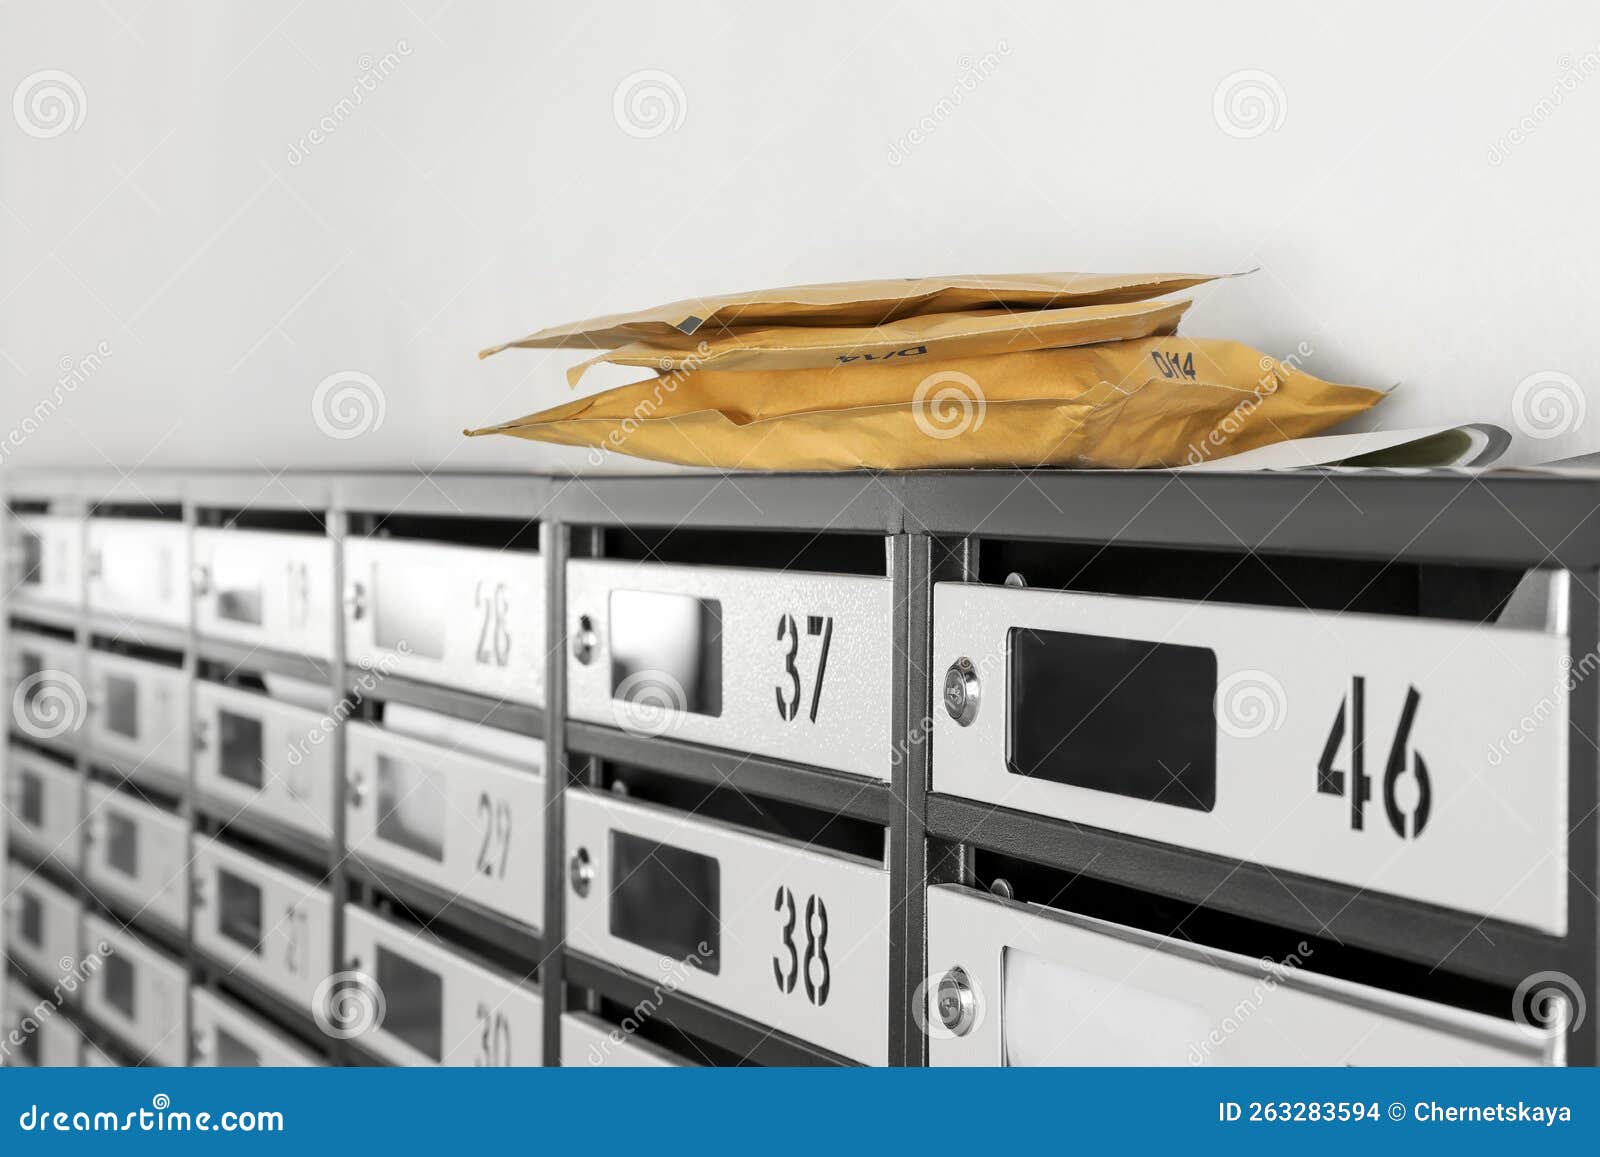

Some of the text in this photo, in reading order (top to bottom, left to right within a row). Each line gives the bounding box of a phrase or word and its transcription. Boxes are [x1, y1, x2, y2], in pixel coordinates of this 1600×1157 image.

[1151, 351, 1196, 381] D/14
[474, 578, 511, 668] 28
[775, 613, 833, 725] 37
[1316, 675, 1432, 840] 46
[476, 791, 512, 880] 29
[773, 884, 830, 1008] 38
